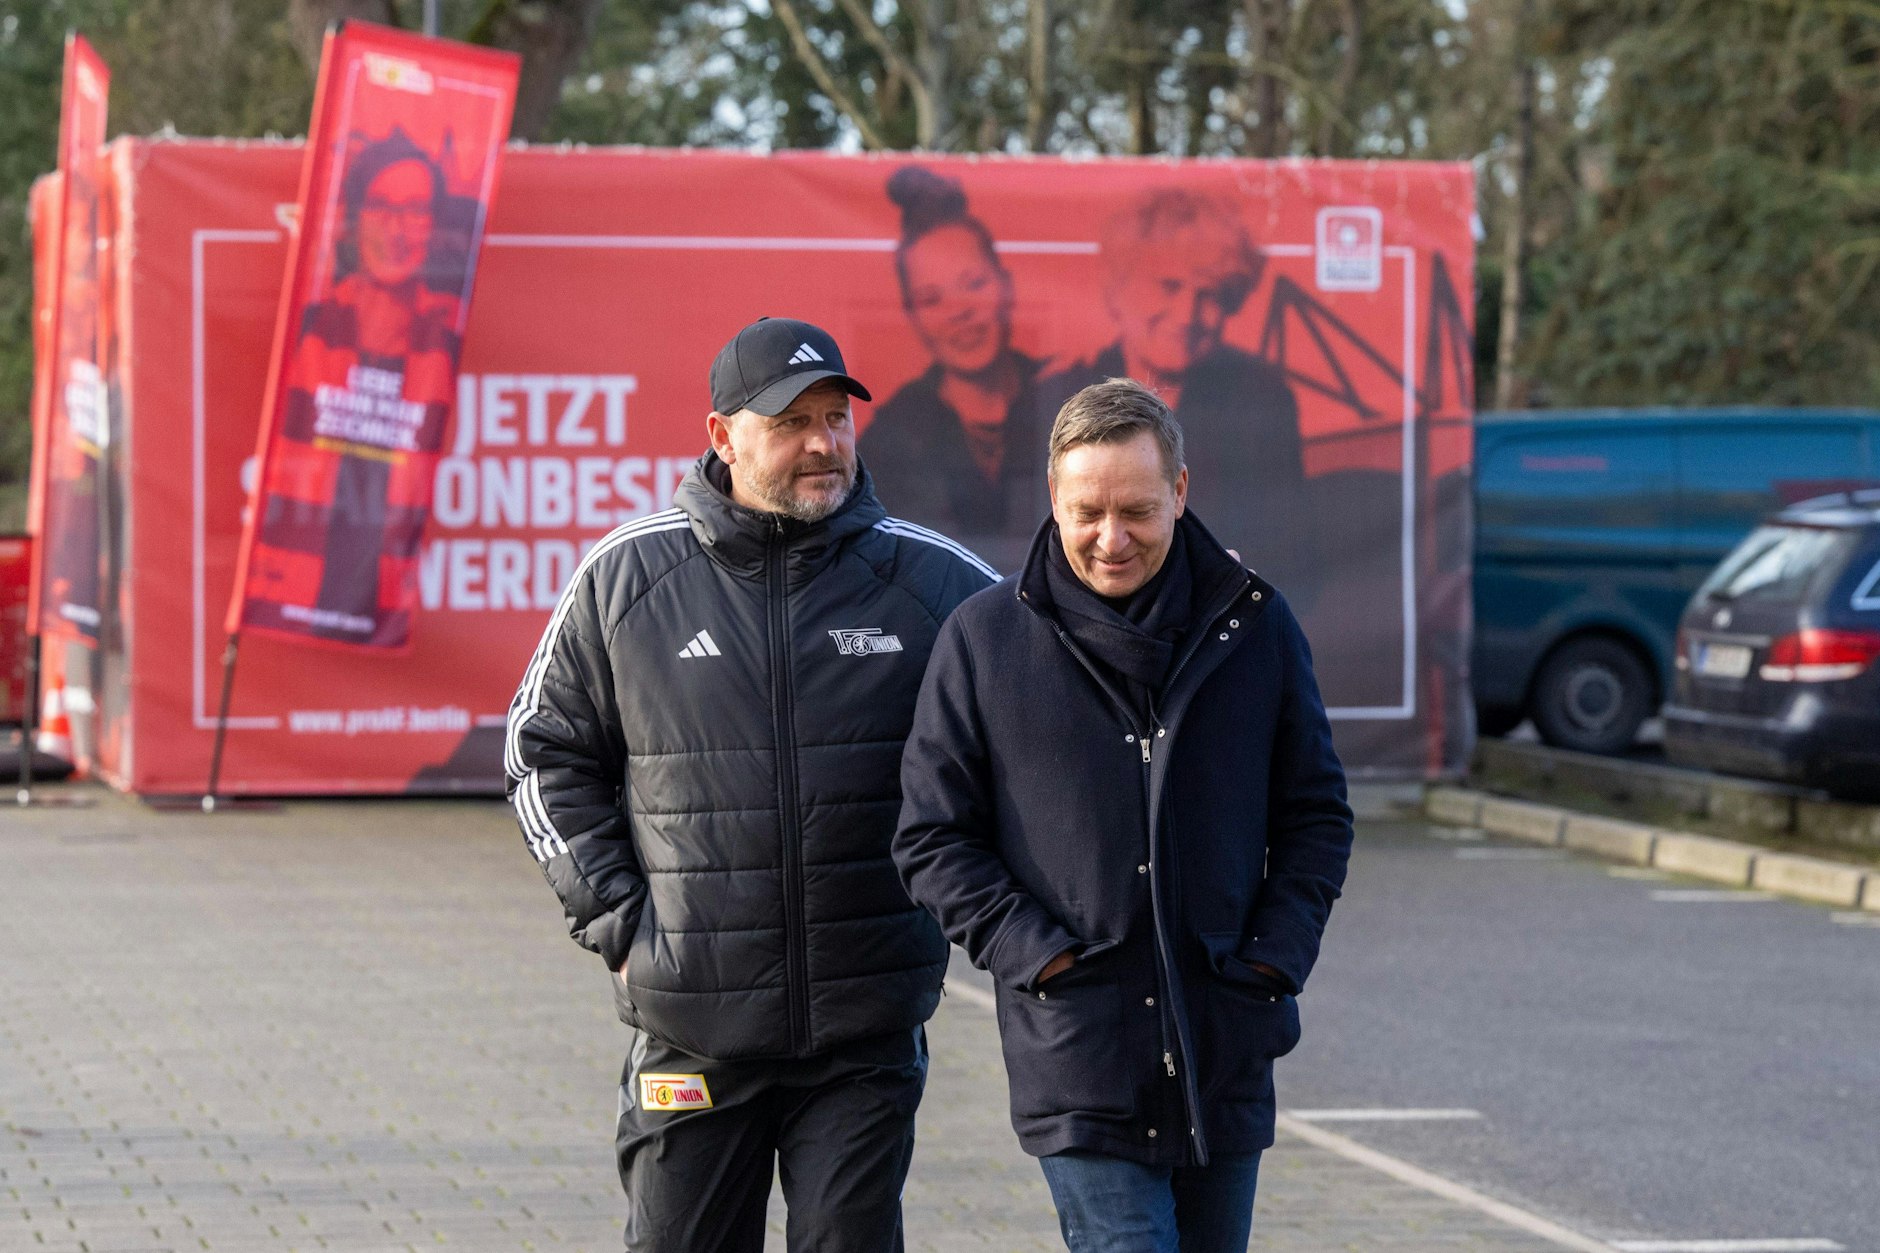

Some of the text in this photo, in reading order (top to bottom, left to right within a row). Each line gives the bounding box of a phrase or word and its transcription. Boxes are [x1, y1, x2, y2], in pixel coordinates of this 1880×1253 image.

[454, 374, 637, 456] JETZT
[869, 635, 903, 653] UNION
[673, 1088, 704, 1103] UNION
